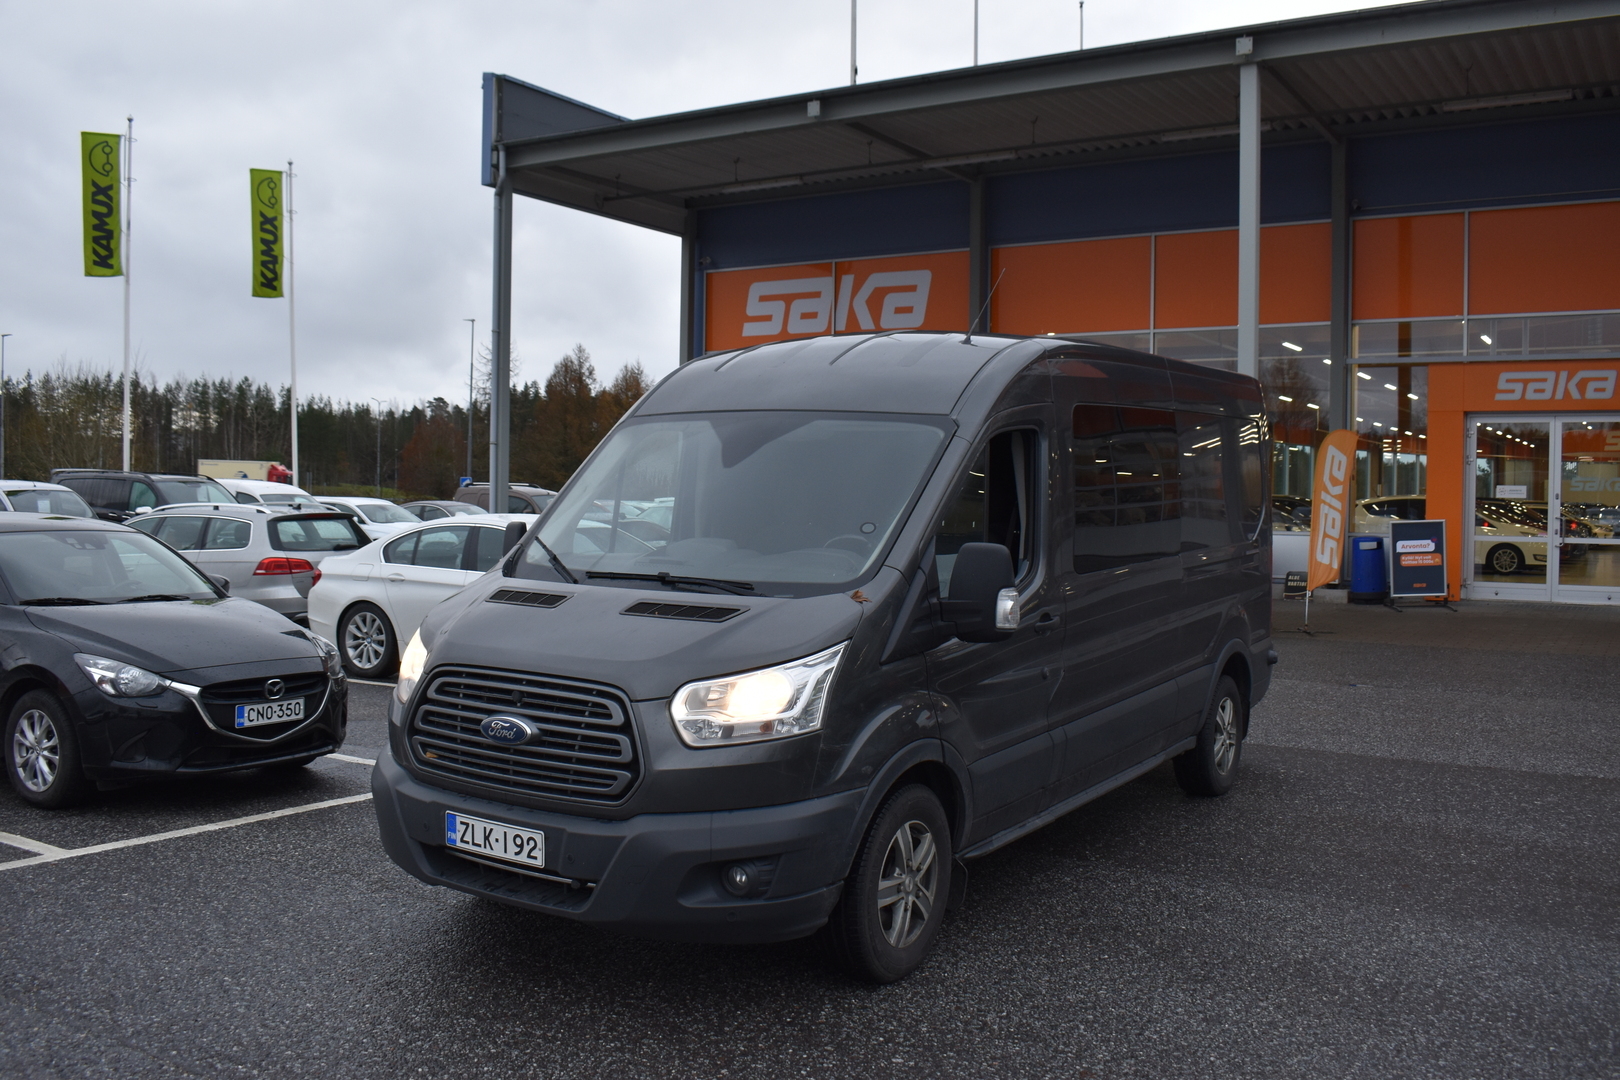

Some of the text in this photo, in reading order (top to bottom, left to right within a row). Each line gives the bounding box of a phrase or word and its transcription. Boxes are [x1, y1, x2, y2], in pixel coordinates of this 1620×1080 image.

[91, 179, 114, 269] KAMUX
[259, 210, 279, 291] KAMUX
[488, 720, 516, 739] Ford
[459, 820, 538, 860] ZLK-192
